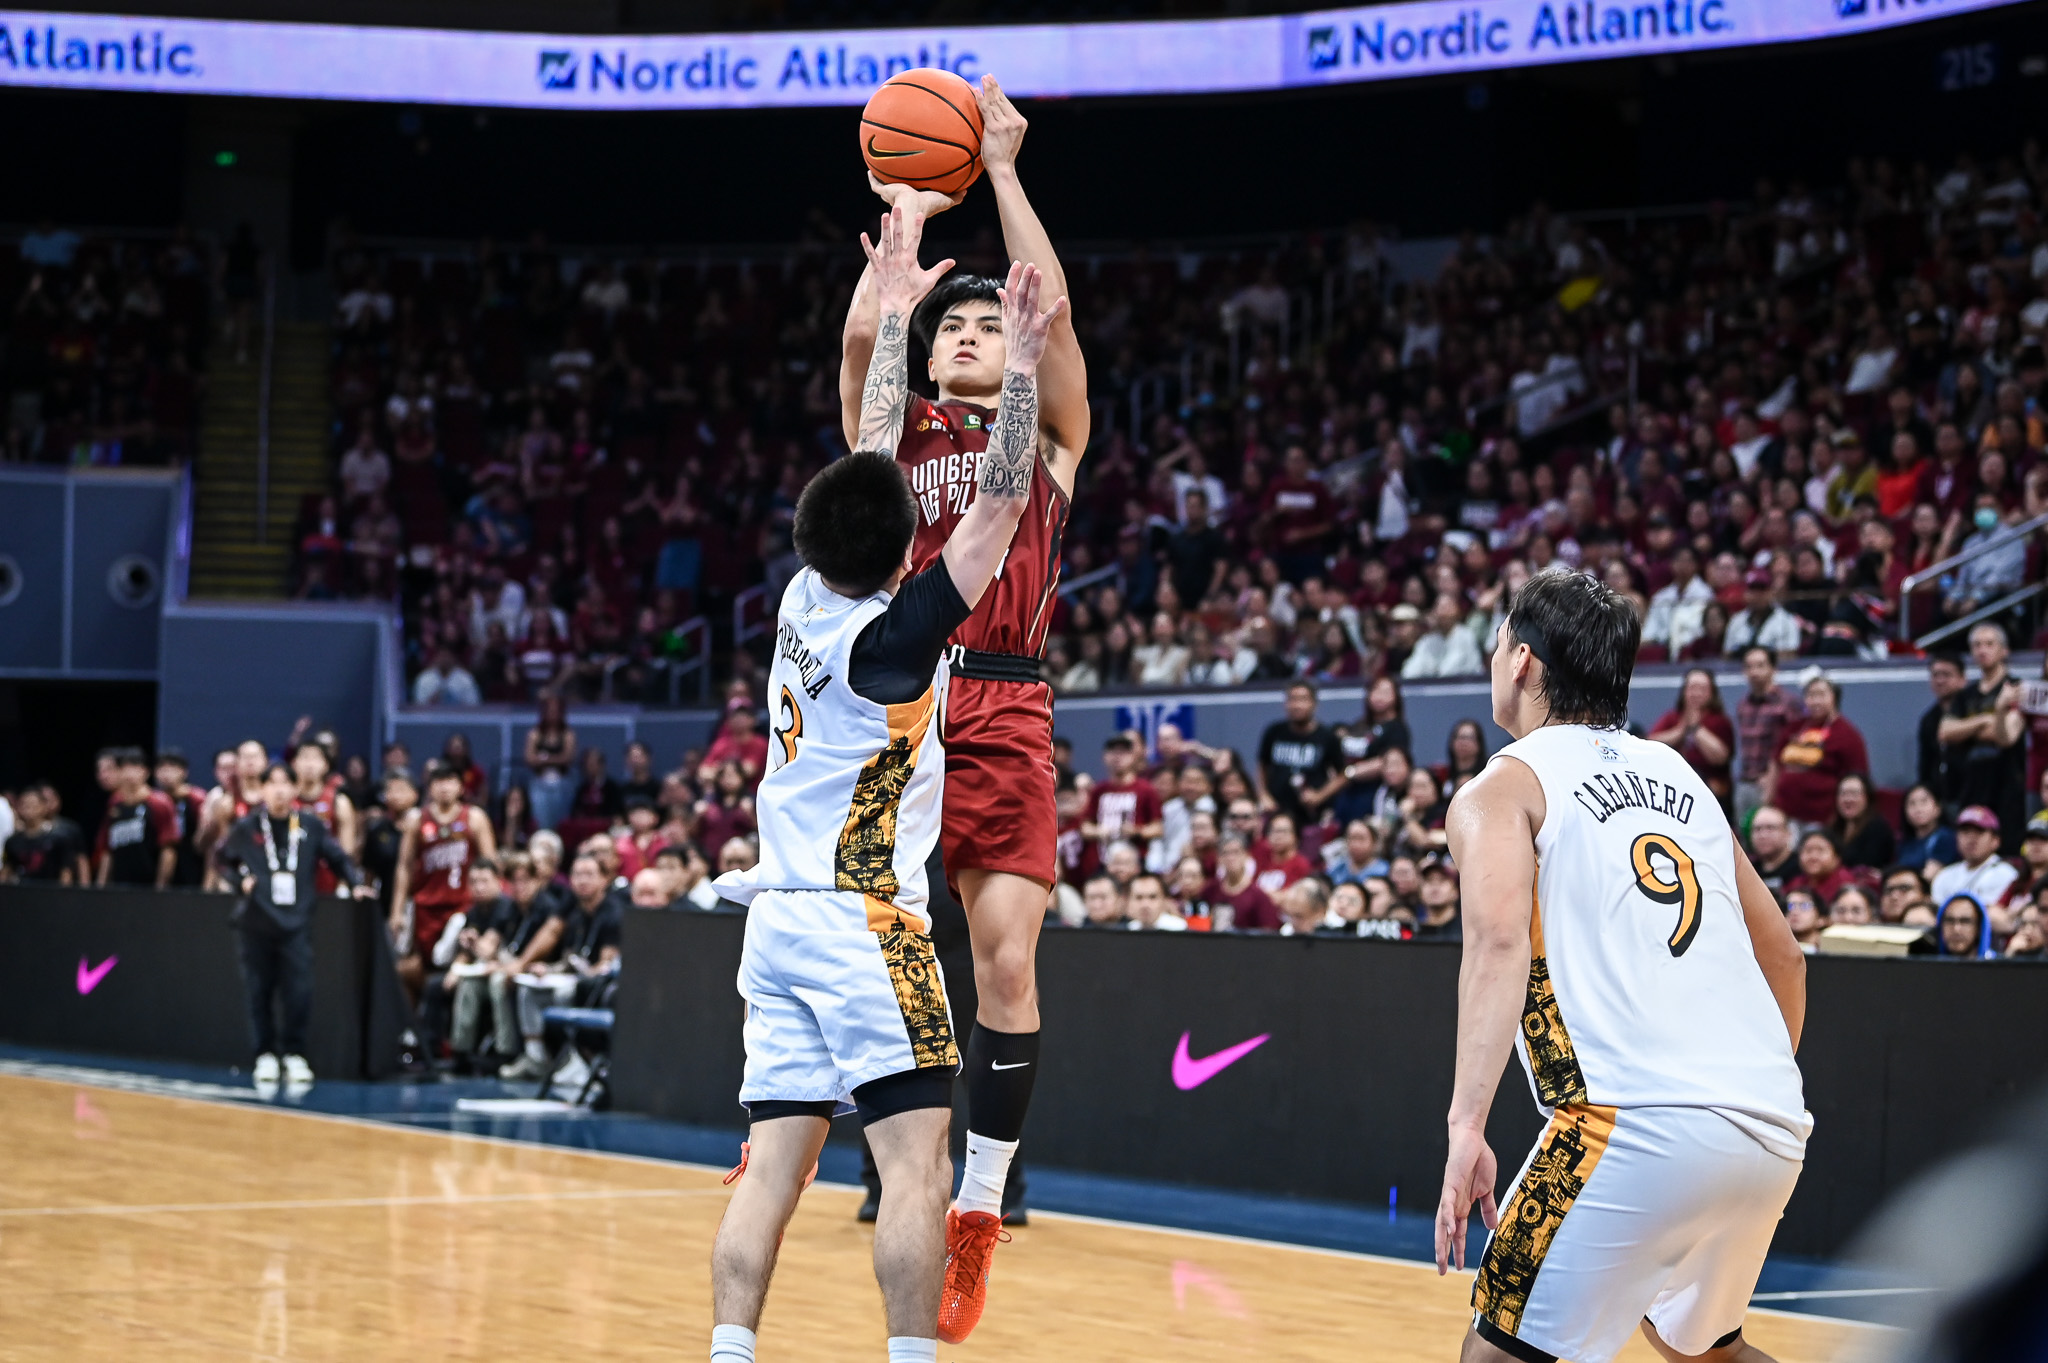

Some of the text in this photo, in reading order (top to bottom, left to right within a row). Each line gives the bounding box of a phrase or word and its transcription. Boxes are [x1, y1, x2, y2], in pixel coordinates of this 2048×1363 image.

[1351, 10, 1509, 66] Nordic
[590, 47, 758, 92] Nordic
[1943, 43, 1994, 90] 215
[1573, 770, 1694, 825] CABAÑERO
[1629, 832, 1703, 958] 9
